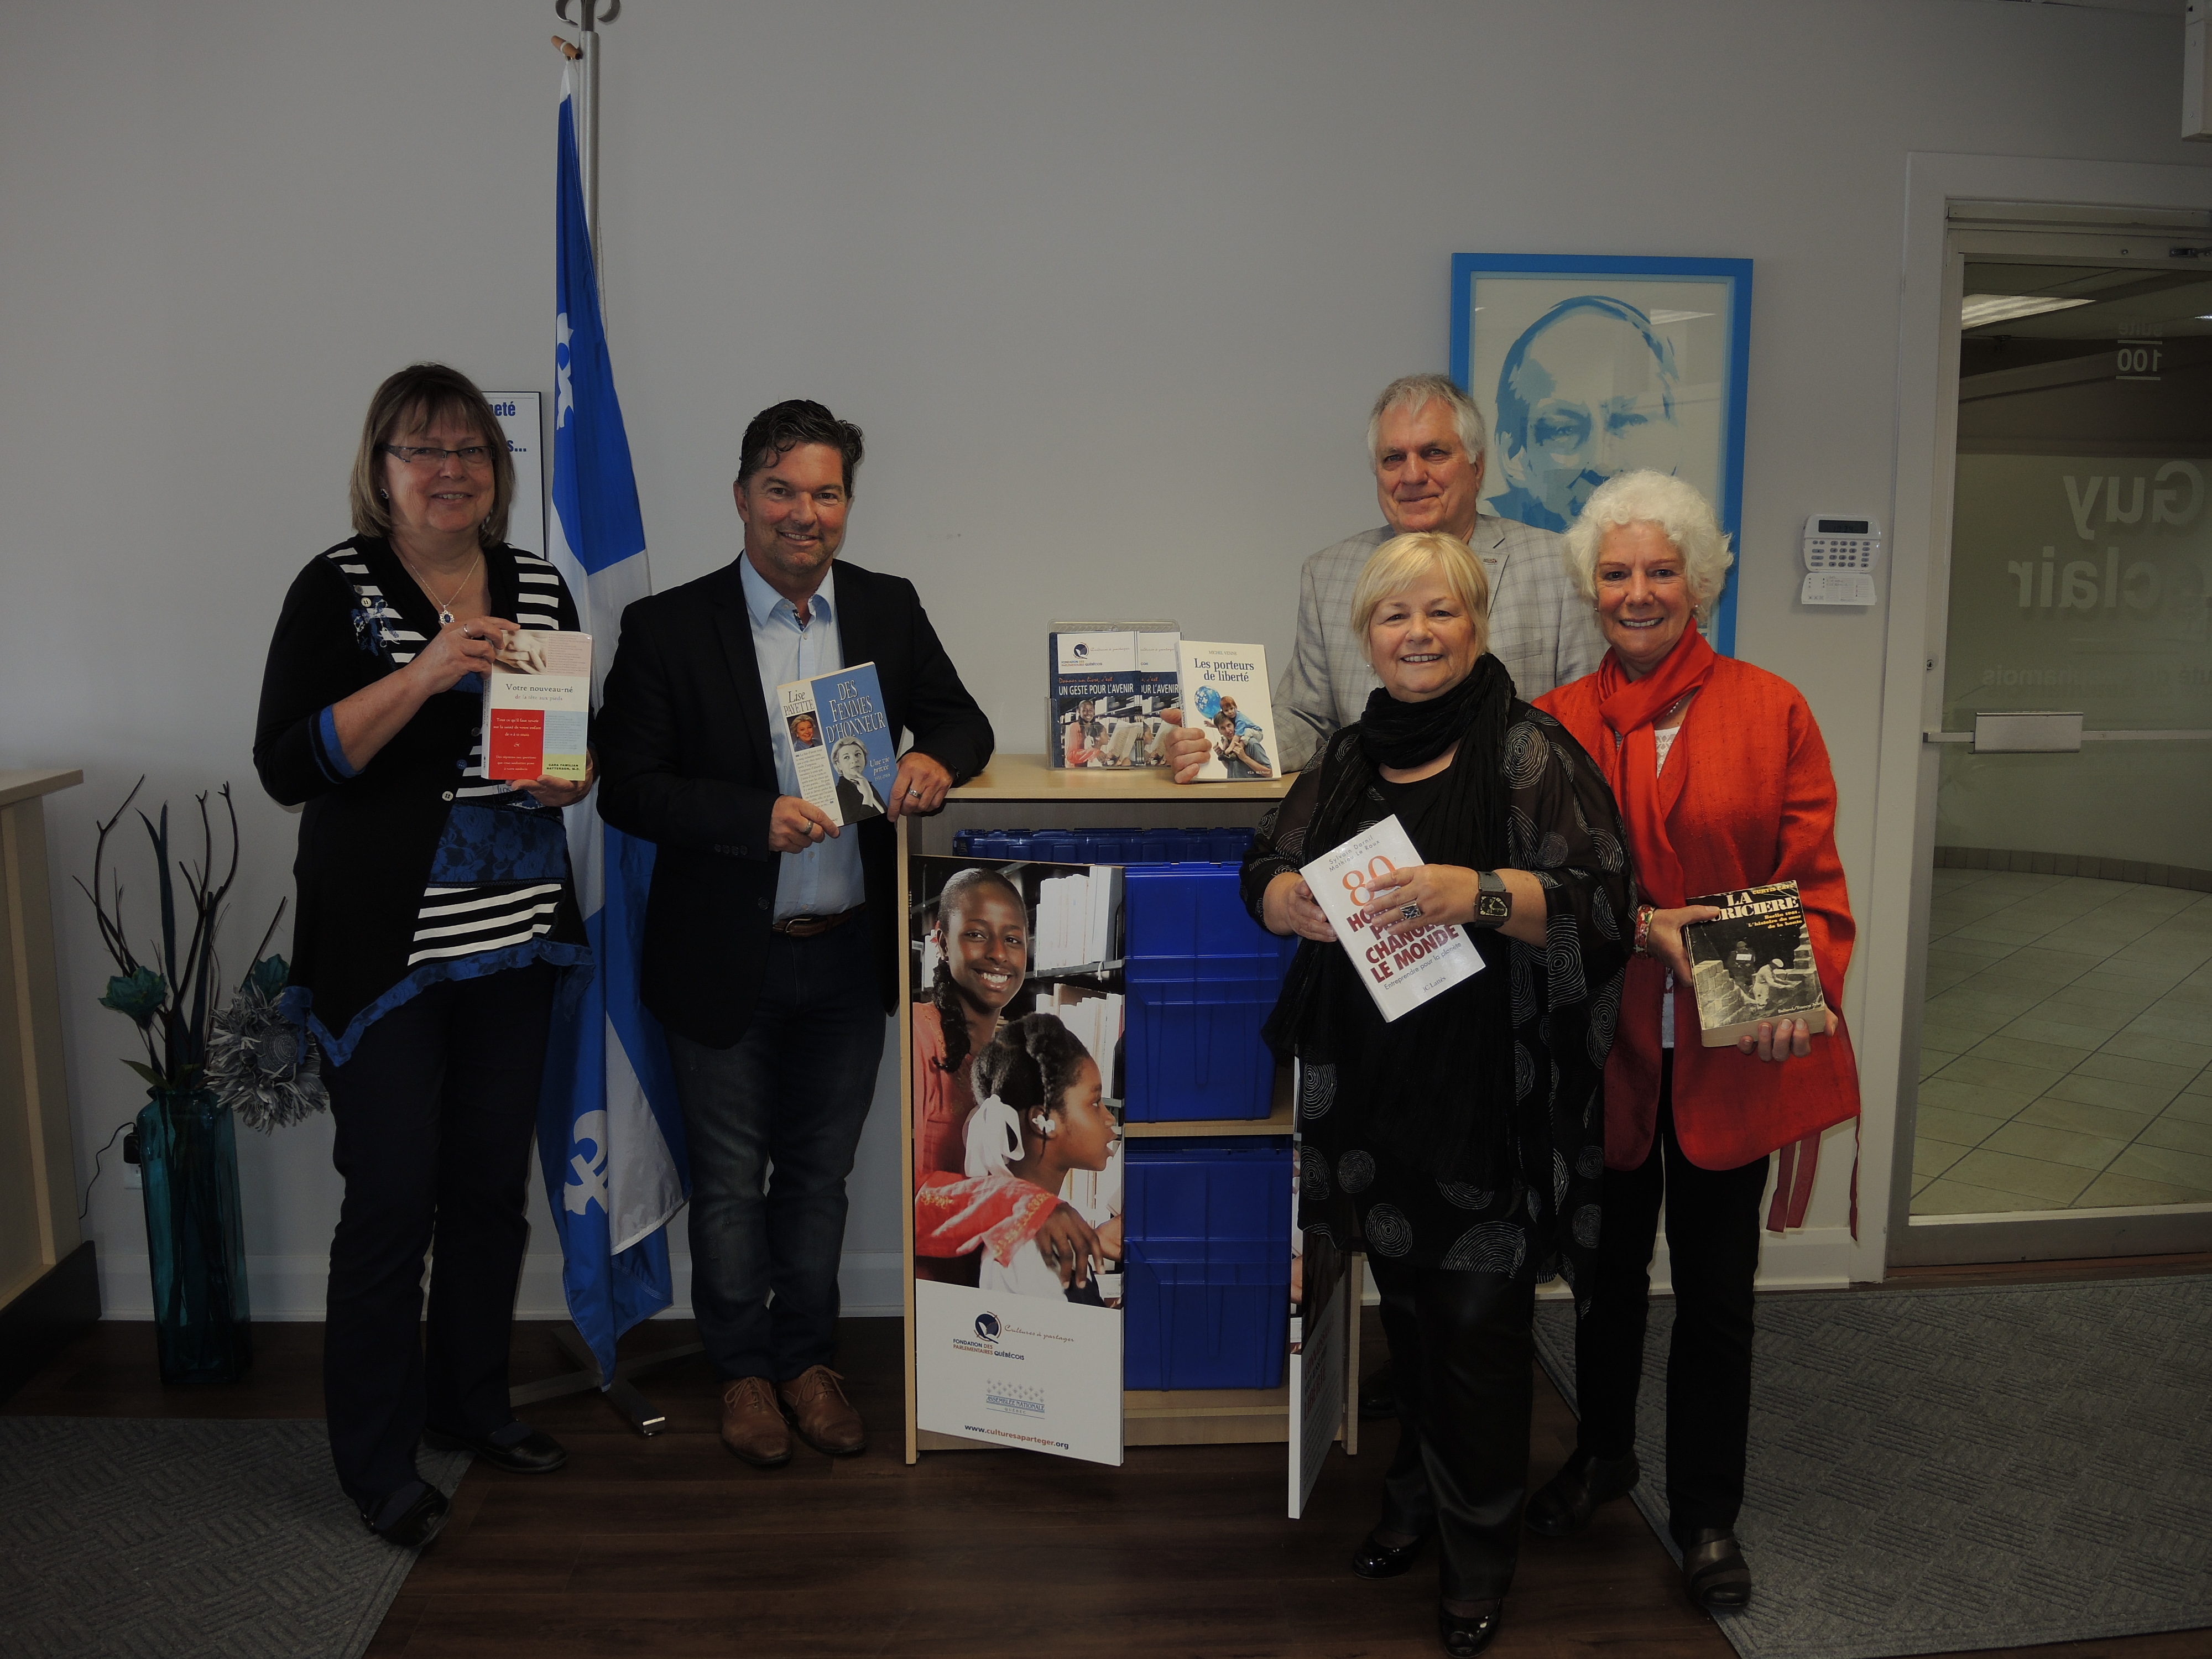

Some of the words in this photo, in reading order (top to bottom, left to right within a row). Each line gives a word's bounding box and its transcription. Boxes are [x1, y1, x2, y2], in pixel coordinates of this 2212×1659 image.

[1194, 658, 1211, 669] Les
[1213, 660, 1254, 672] porteurs
[1204, 670, 1215, 681] de
[1218, 670, 1249, 682] liberté
[787, 690, 805, 703] Lise
[837, 680, 858, 701] DES
[1058, 685, 1068, 696] UN
[1069, 685, 1088, 695] GESTE
[1089, 684, 1107, 695] POUR
[1108, 682, 1134, 694] L'AVENIR
[1152, 684, 1179, 694] L'AVENIR
[783, 699, 815, 716] PAYETTE
[829, 695, 873, 722] FEMMES
[826, 712, 886, 744] D'HONNEUR
[870, 759, 881, 767] Une
[1329, 849, 1353, 864] Sylvain
[1353, 834, 1374, 849] Darnil
[1364, 840, 1380, 851] Roux
[1342, 855, 1396, 906] 80
[1726, 891, 1753, 907] LA
[1748, 919, 1778, 927] L'histoire
[1370, 961, 1394, 983] LE
[1393, 924, 1459, 971] MONDE
[1384, 967, 1420, 990] Entreprendre
[1420, 958, 1433, 971] pour
[1433, 952, 1440, 961] la
[1441, 942, 1462, 958] planète
[1004, 1324, 1035, 1336] Cultures
[1043, 1334, 1074, 1343] partager
[953, 1338, 982, 1348] FONDATION
[953, 1344, 993, 1355] PARLEMENTAIRES
[994, 1350, 1025, 1360] QUÉBÉCOIS
[987, 1396, 1015, 1406] ASSEMBLÉE
[1016, 1400, 1045, 1411] NATIONALE
